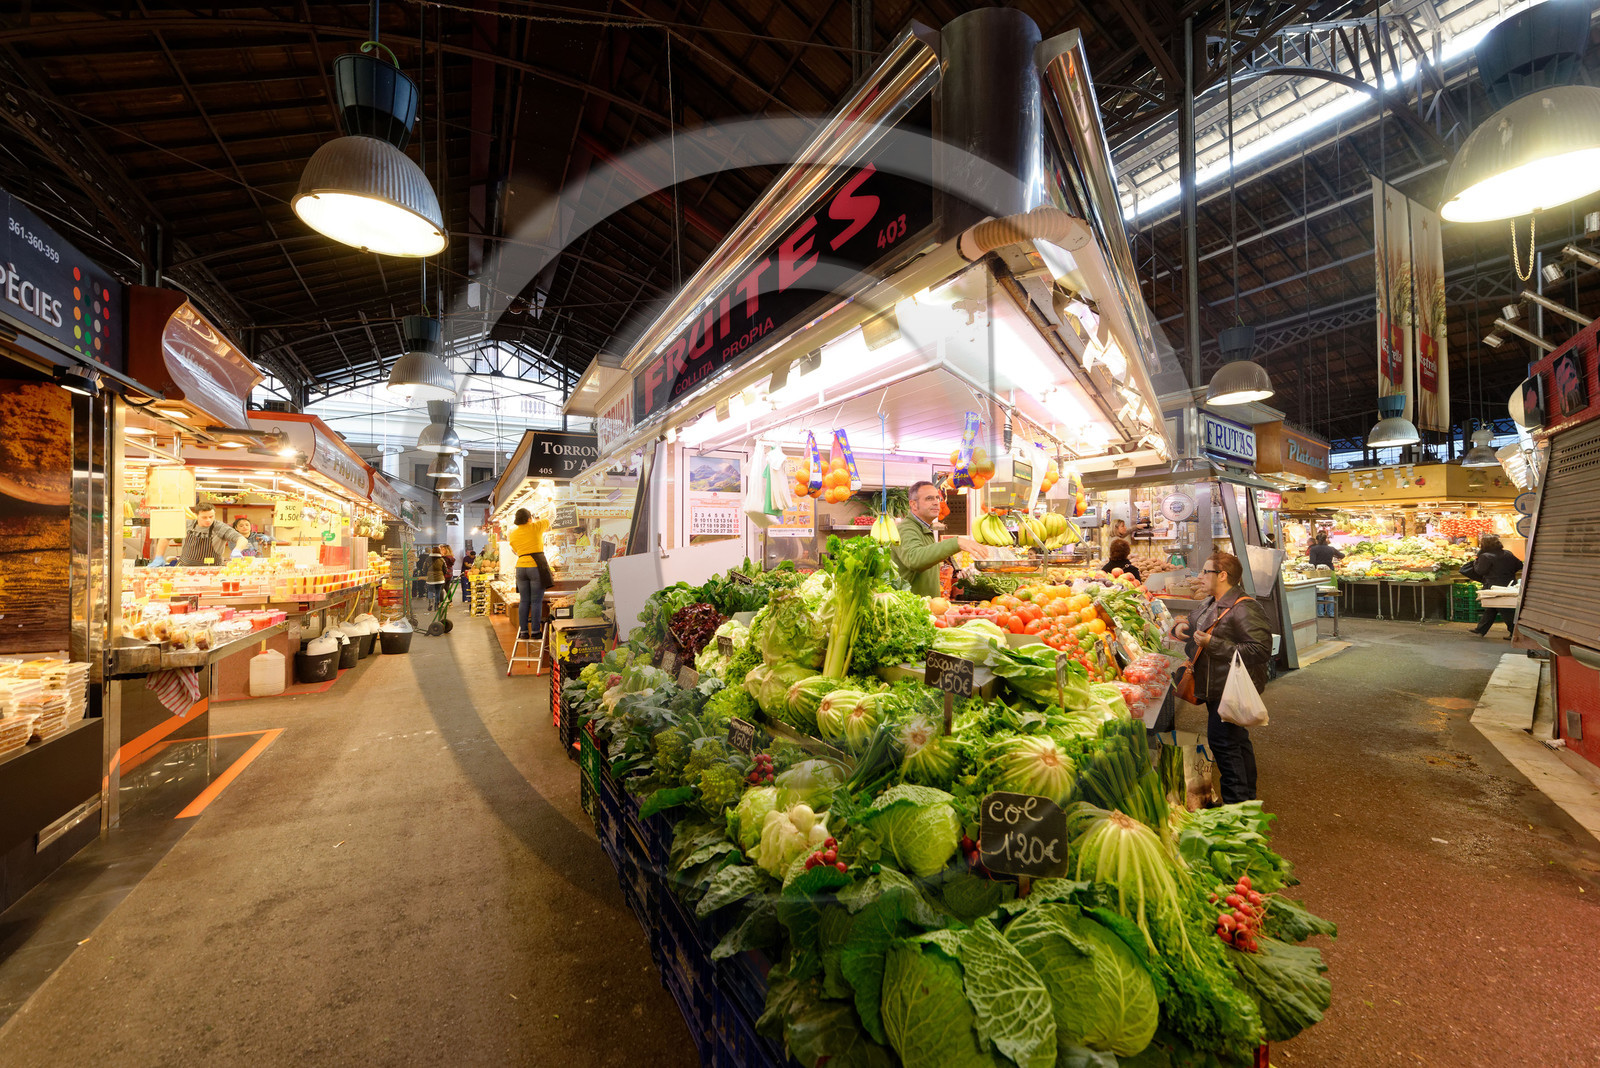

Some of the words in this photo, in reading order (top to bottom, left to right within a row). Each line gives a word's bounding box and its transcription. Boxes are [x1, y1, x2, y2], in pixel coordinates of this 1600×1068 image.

[8, 217, 60, 264] 361-360-359
[876, 213, 907, 249] 403
[644, 161, 881, 415] FRUITES
[675, 361, 714, 395] COLLITA
[722, 316, 775, 362] PROPIA
[1206, 419, 1254, 458] FRUTAS
[538, 467, 553, 475] 405
